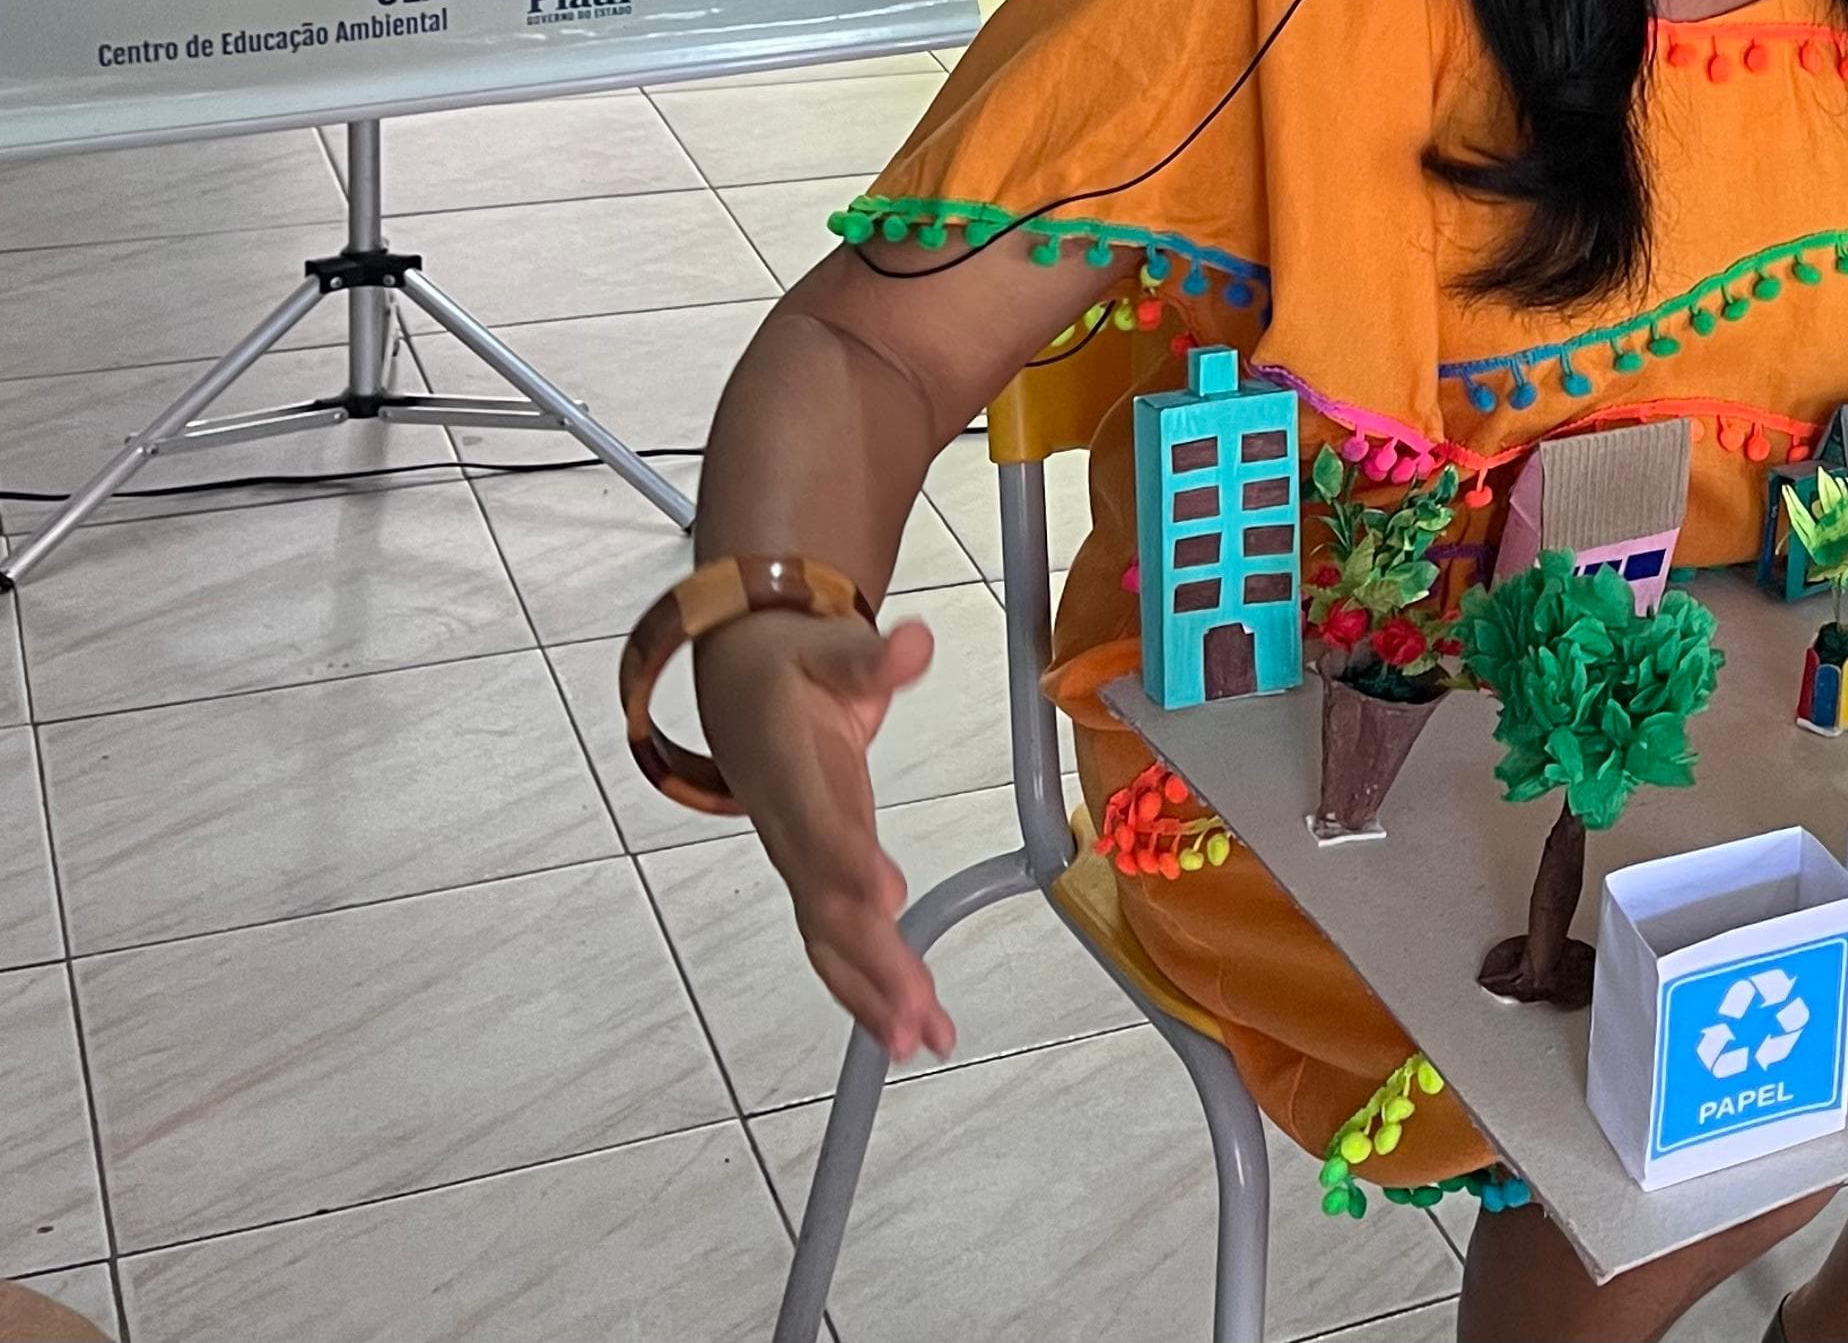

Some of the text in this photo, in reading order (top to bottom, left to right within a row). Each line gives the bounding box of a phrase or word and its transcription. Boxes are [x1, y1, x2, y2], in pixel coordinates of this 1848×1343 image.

[98, 8, 448, 68] Centro de Educação Ambiental
[1698, 1084, 1794, 1125] PAPEL
